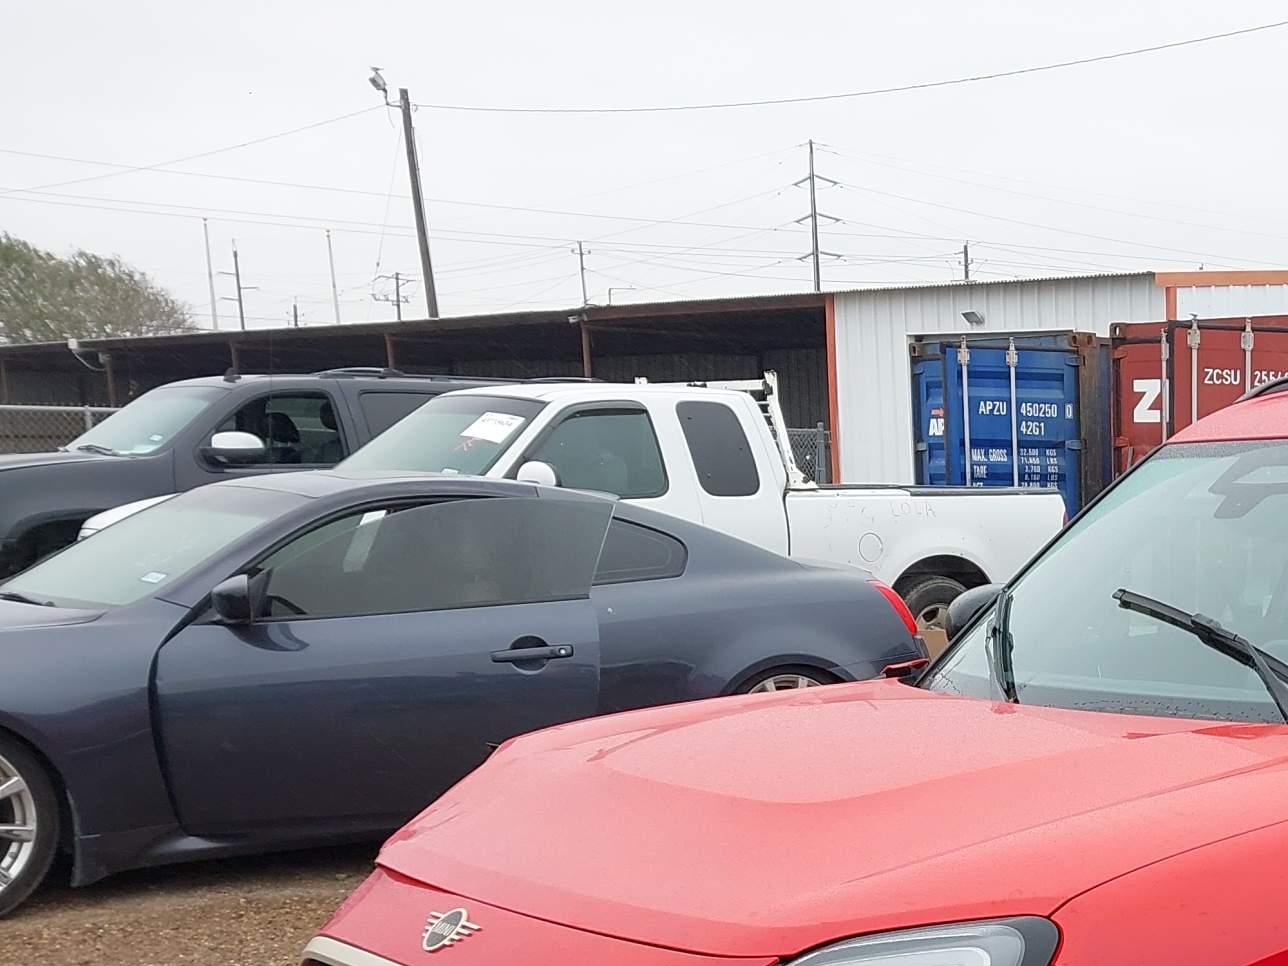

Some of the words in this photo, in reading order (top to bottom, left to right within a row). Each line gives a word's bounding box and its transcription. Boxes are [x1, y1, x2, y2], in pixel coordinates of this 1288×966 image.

[1204, 368, 1240, 385] ZCSU
[978, 400, 1007, 415] APZU
[1020, 403, 1058, 417] 450250
[1020, 421, 1045, 436] 42G1
[971, 448, 988, 461] MAX.
[988, 448, 1007, 462] GROSS
[1046, 448, 1057, 456] KGS
[973, 465, 988, 479] TARE
[1047, 465, 1058, 473] KGS
